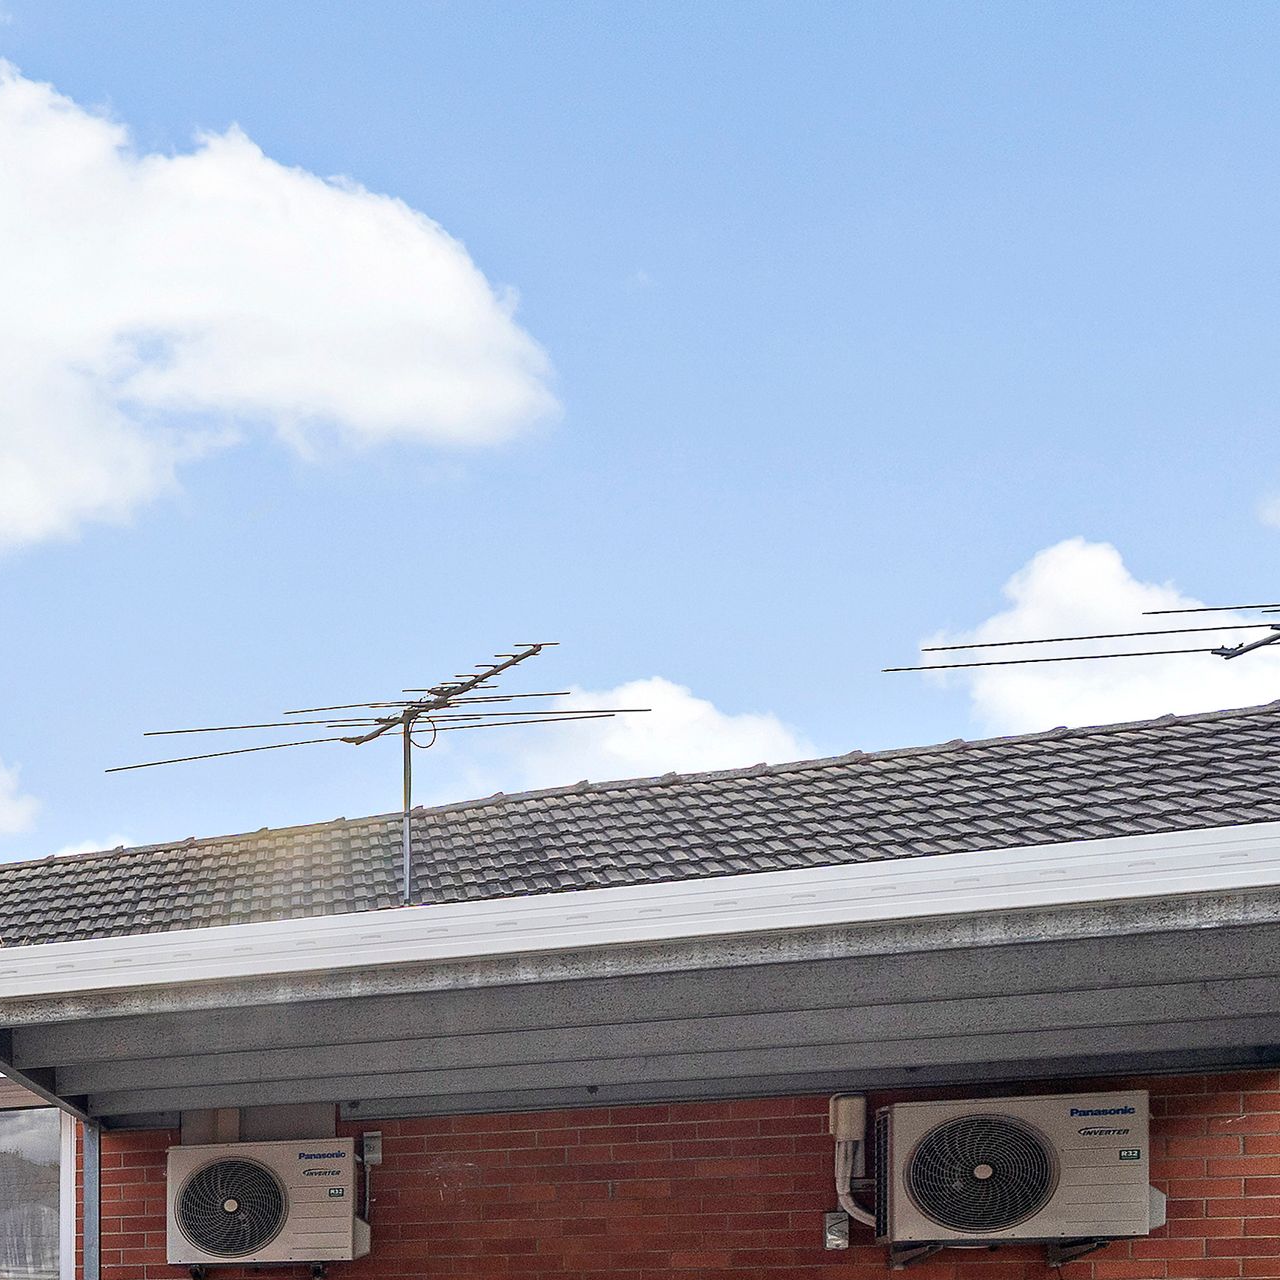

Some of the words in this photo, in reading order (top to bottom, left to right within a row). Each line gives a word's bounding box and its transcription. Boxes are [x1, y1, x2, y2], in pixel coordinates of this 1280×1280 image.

[1070, 1106, 1136, 1117] Panasonic
[1078, 1127, 1130, 1136] INVERTER
[298, 1150, 346, 1160] Panasonic
[303, 1168, 341, 1177] INVERTER
